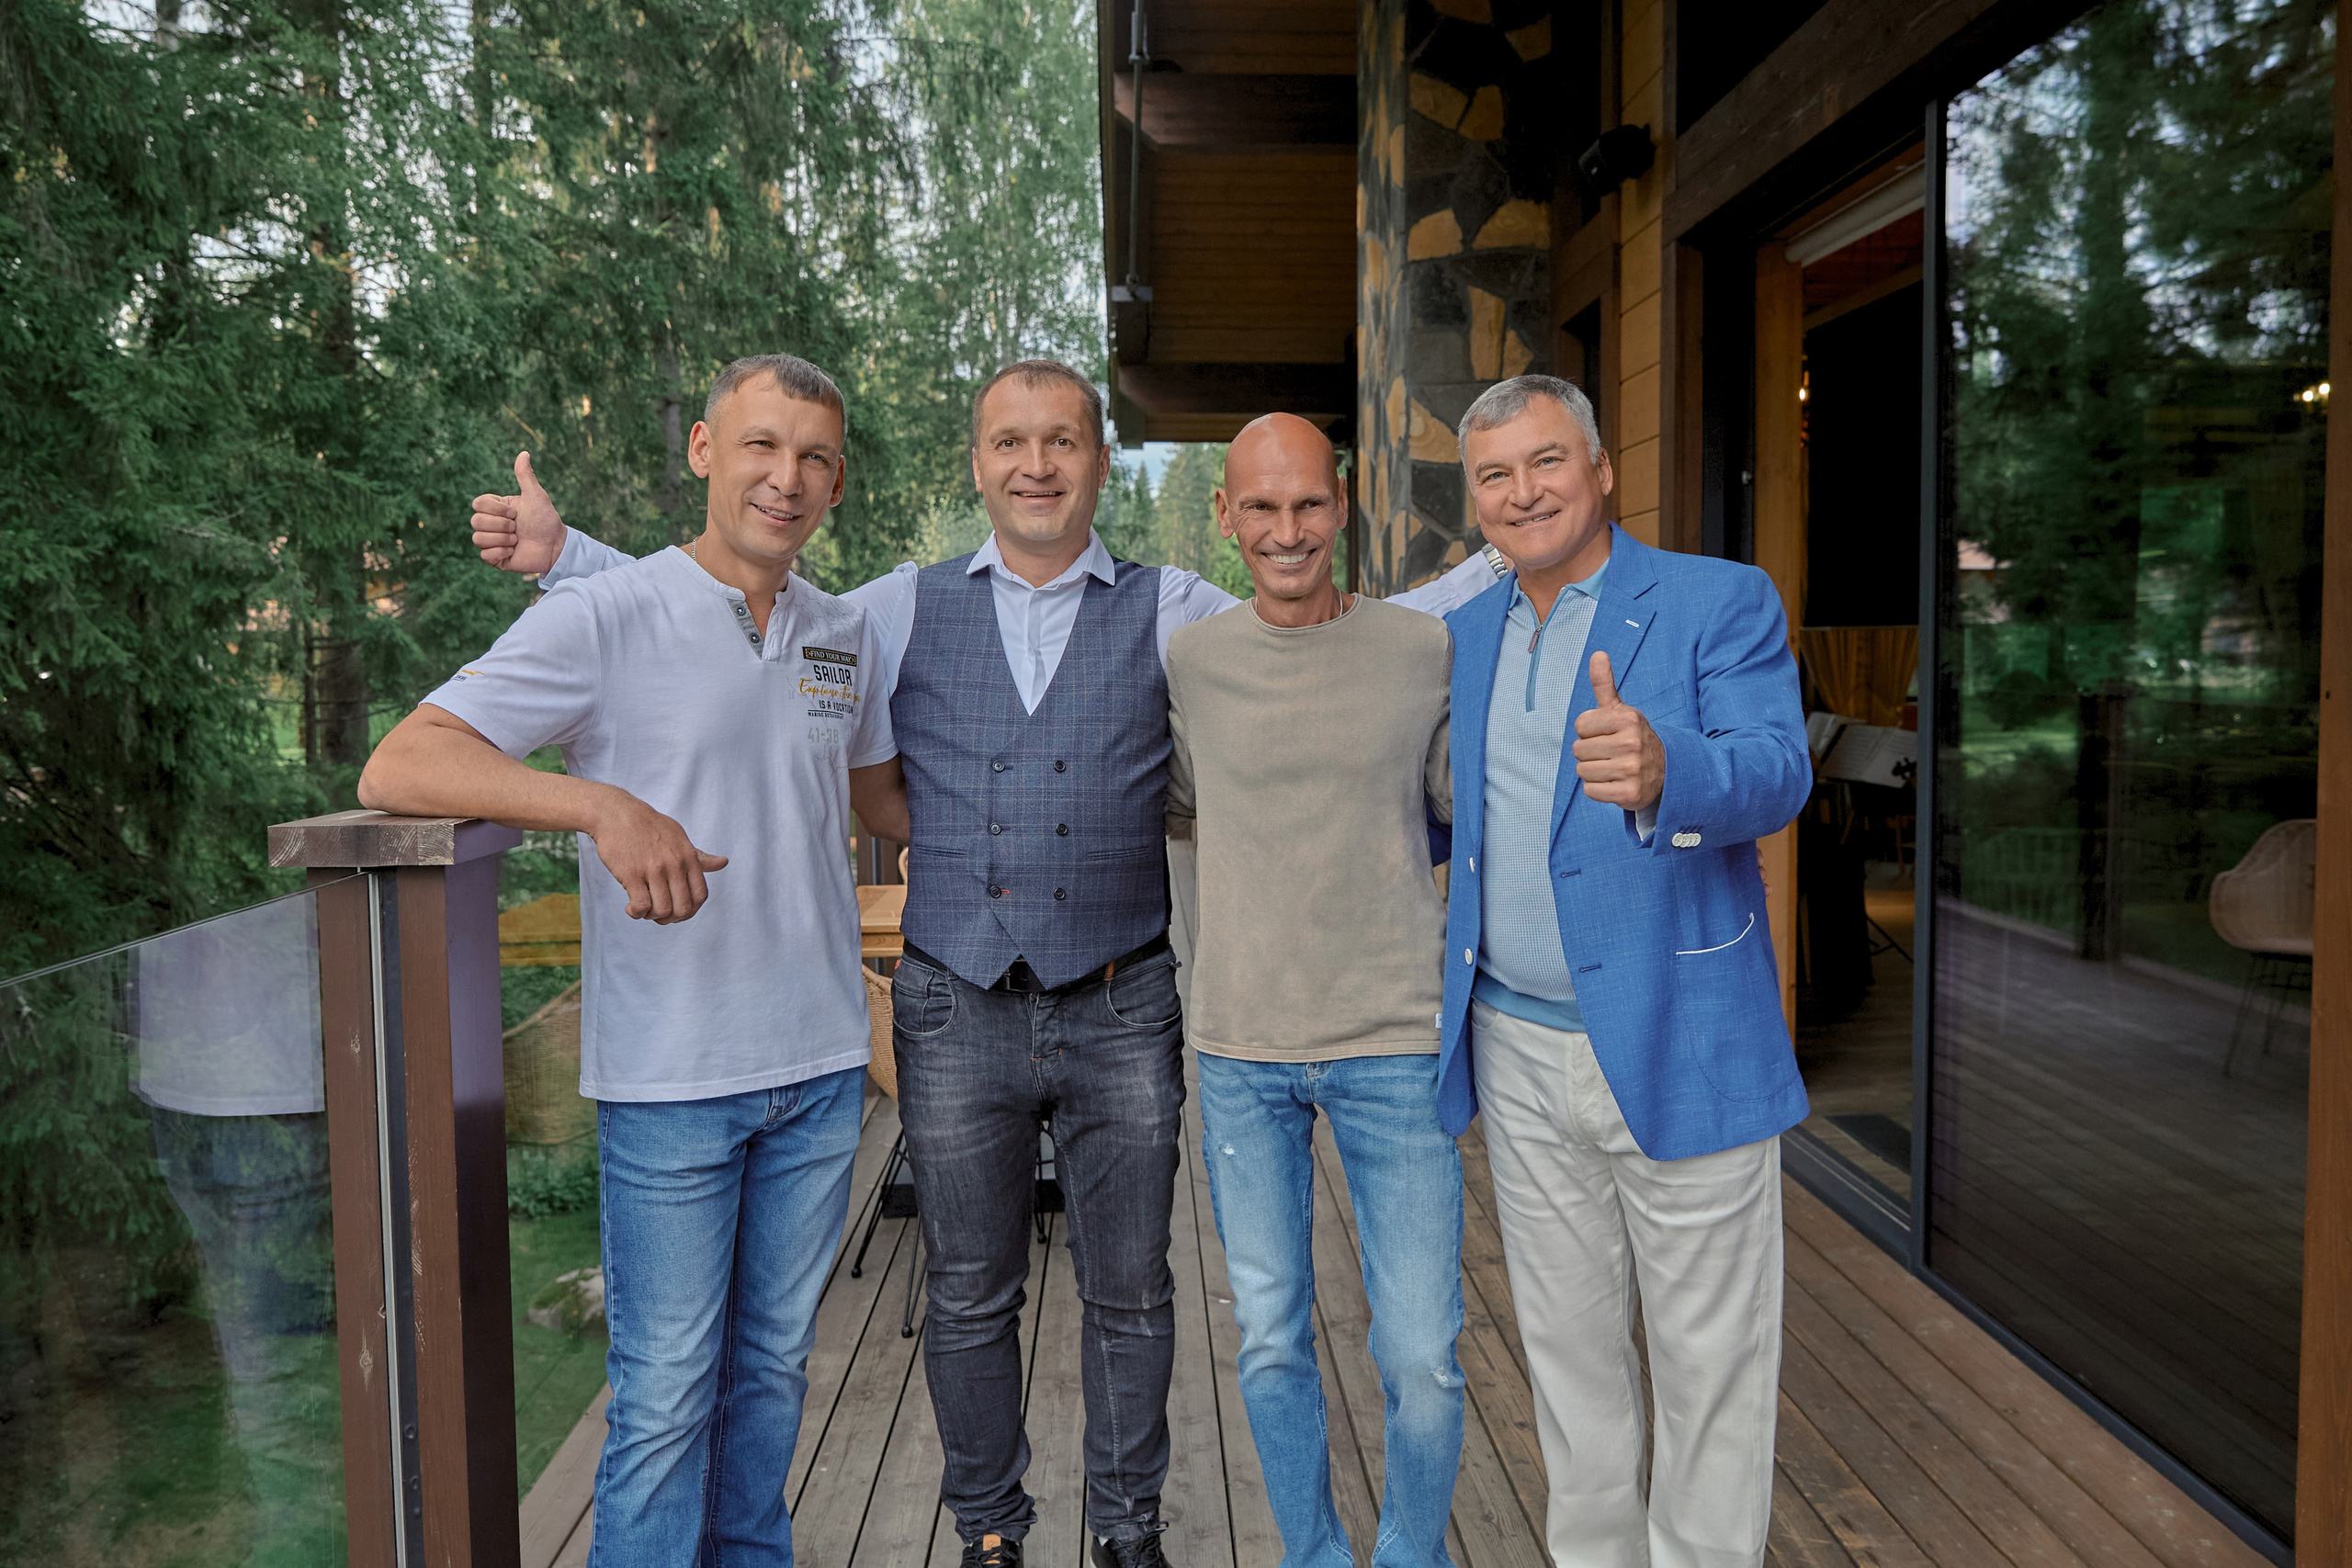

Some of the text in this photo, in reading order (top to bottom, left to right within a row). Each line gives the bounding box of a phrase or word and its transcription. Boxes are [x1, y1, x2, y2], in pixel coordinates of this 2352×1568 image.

[825, 651, 841, 662] YOUR
[840, 654, 852, 663] WAY
[813, 664, 853, 686] SAILOR
[799, 678, 839, 698] Explore
[819, 700, 854, 715] IS A VOCATION
[808, 727, 839, 743] 41-38
